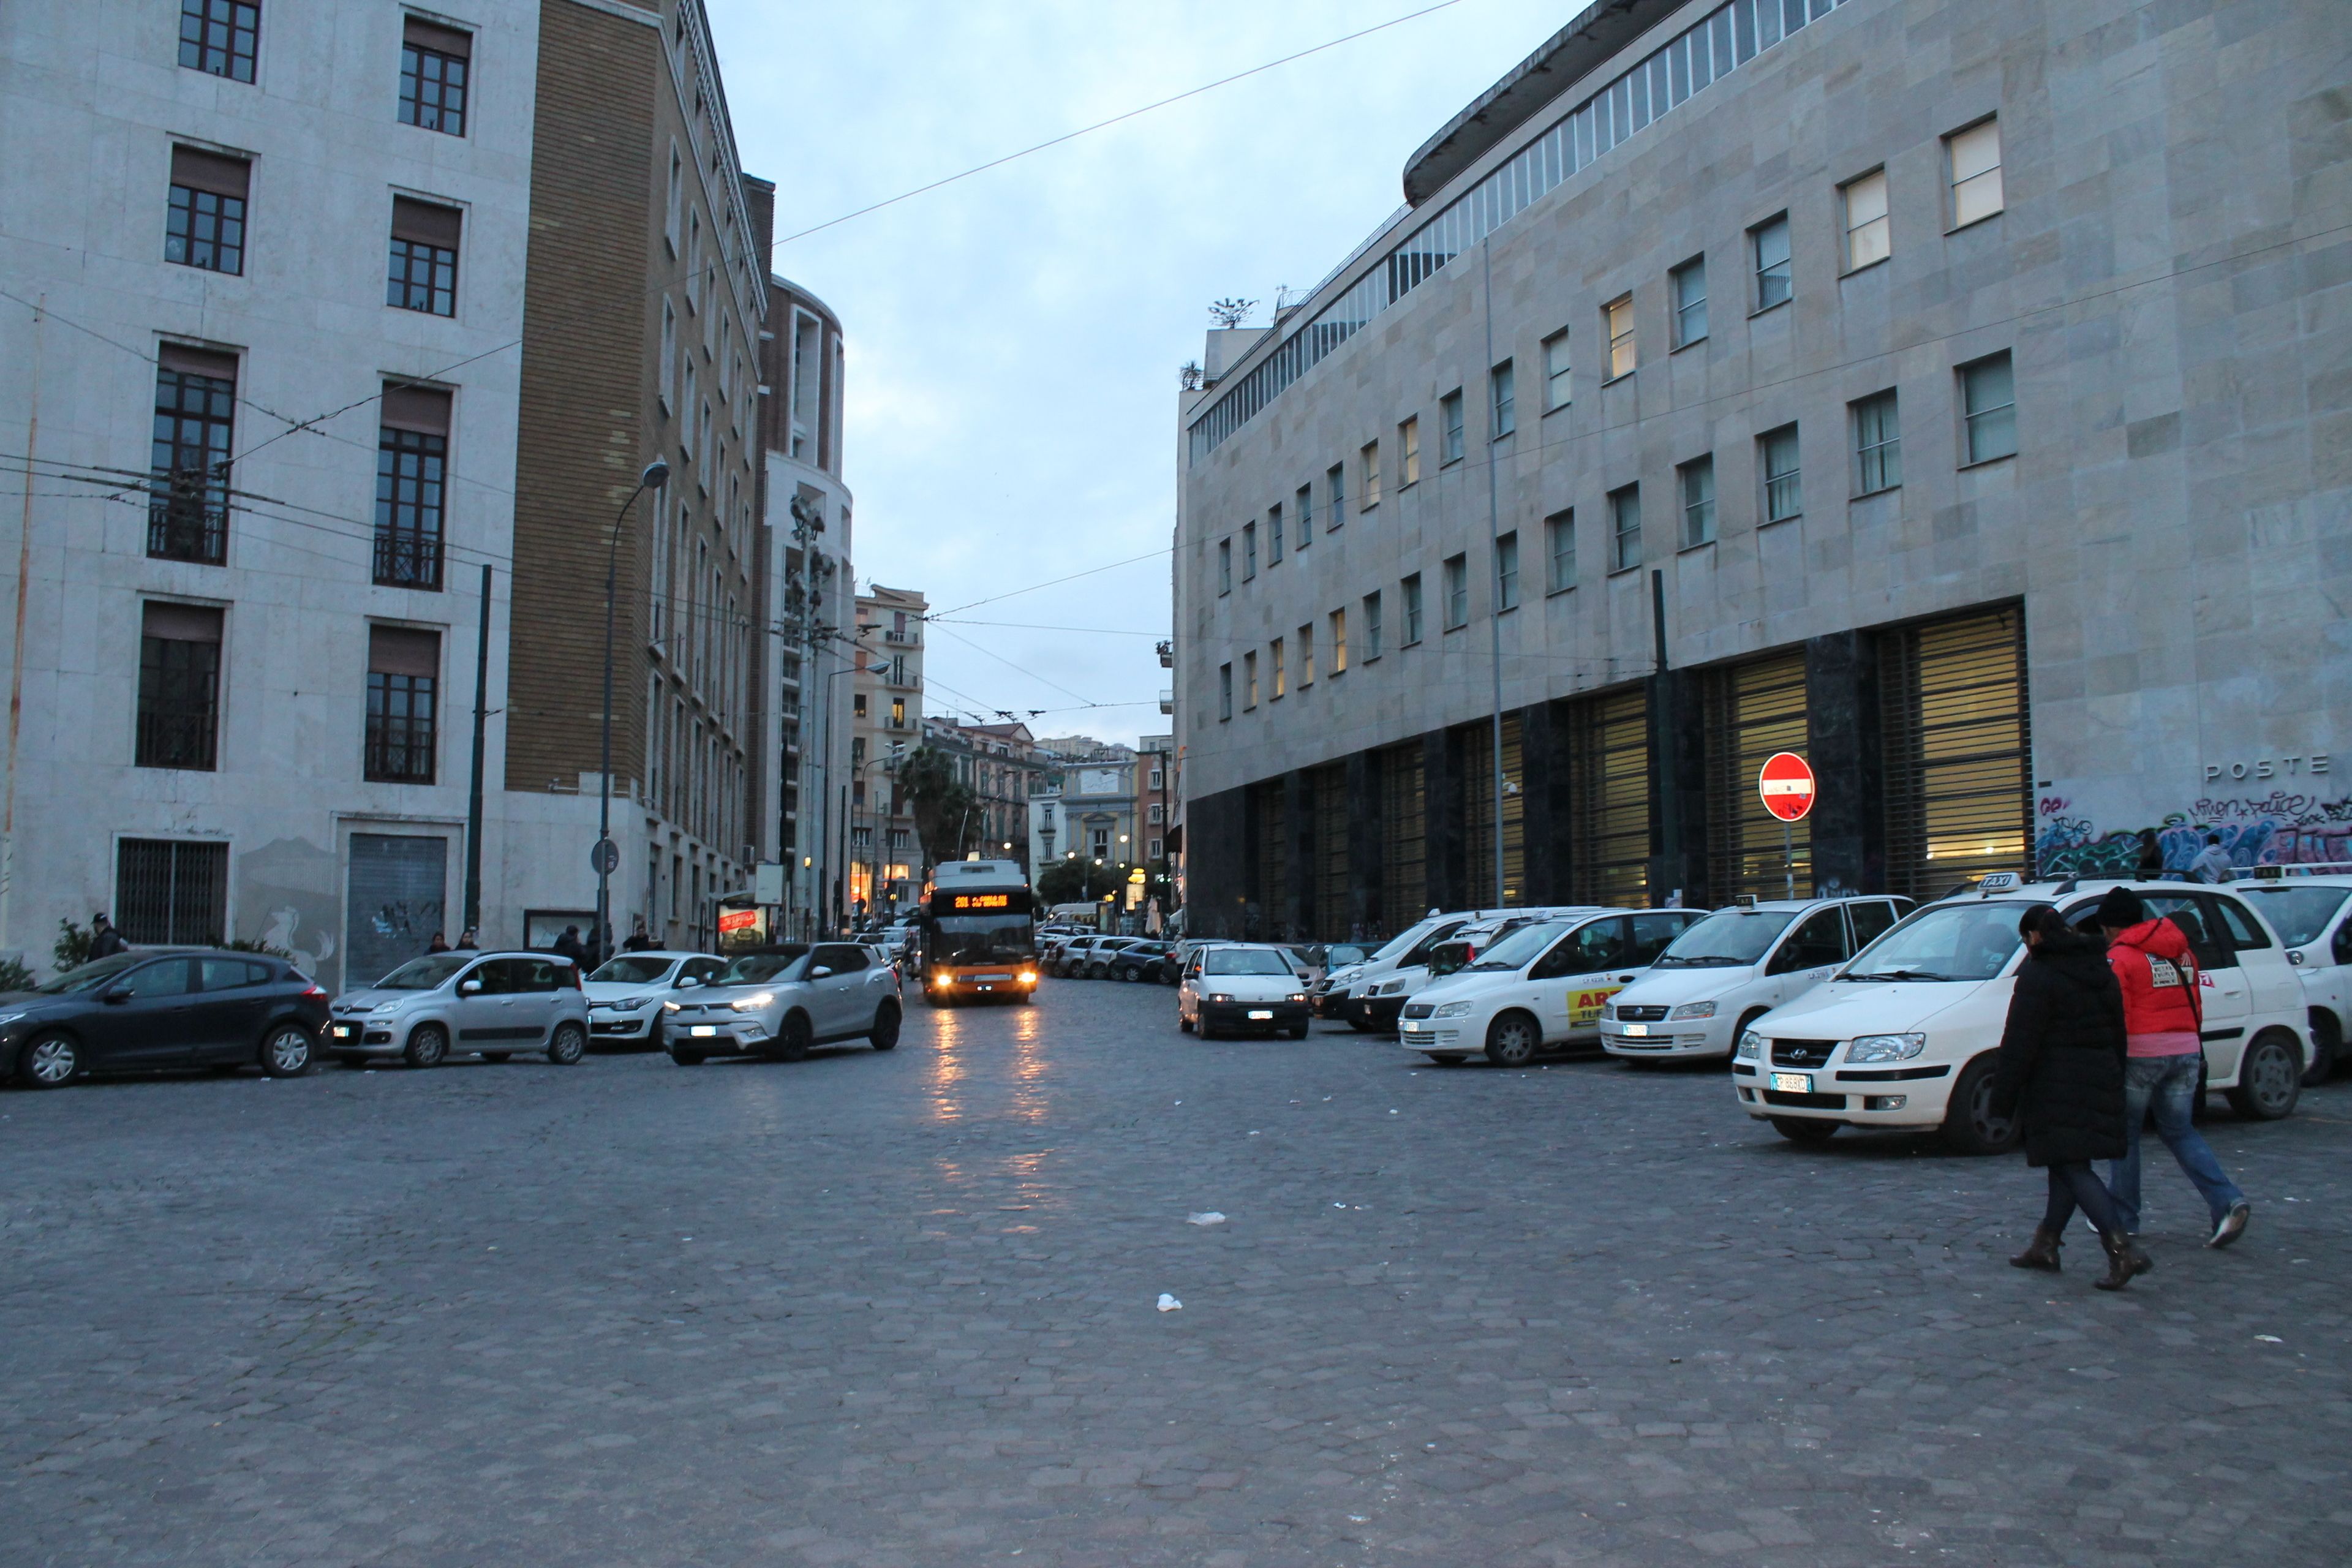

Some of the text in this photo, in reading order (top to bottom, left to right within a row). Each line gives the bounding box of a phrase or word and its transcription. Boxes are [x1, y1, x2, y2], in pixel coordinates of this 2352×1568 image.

[2206, 755, 2328, 782] POSTE
[1983, 875, 2010, 887] TAXI
[956, 897, 968, 908] 201
